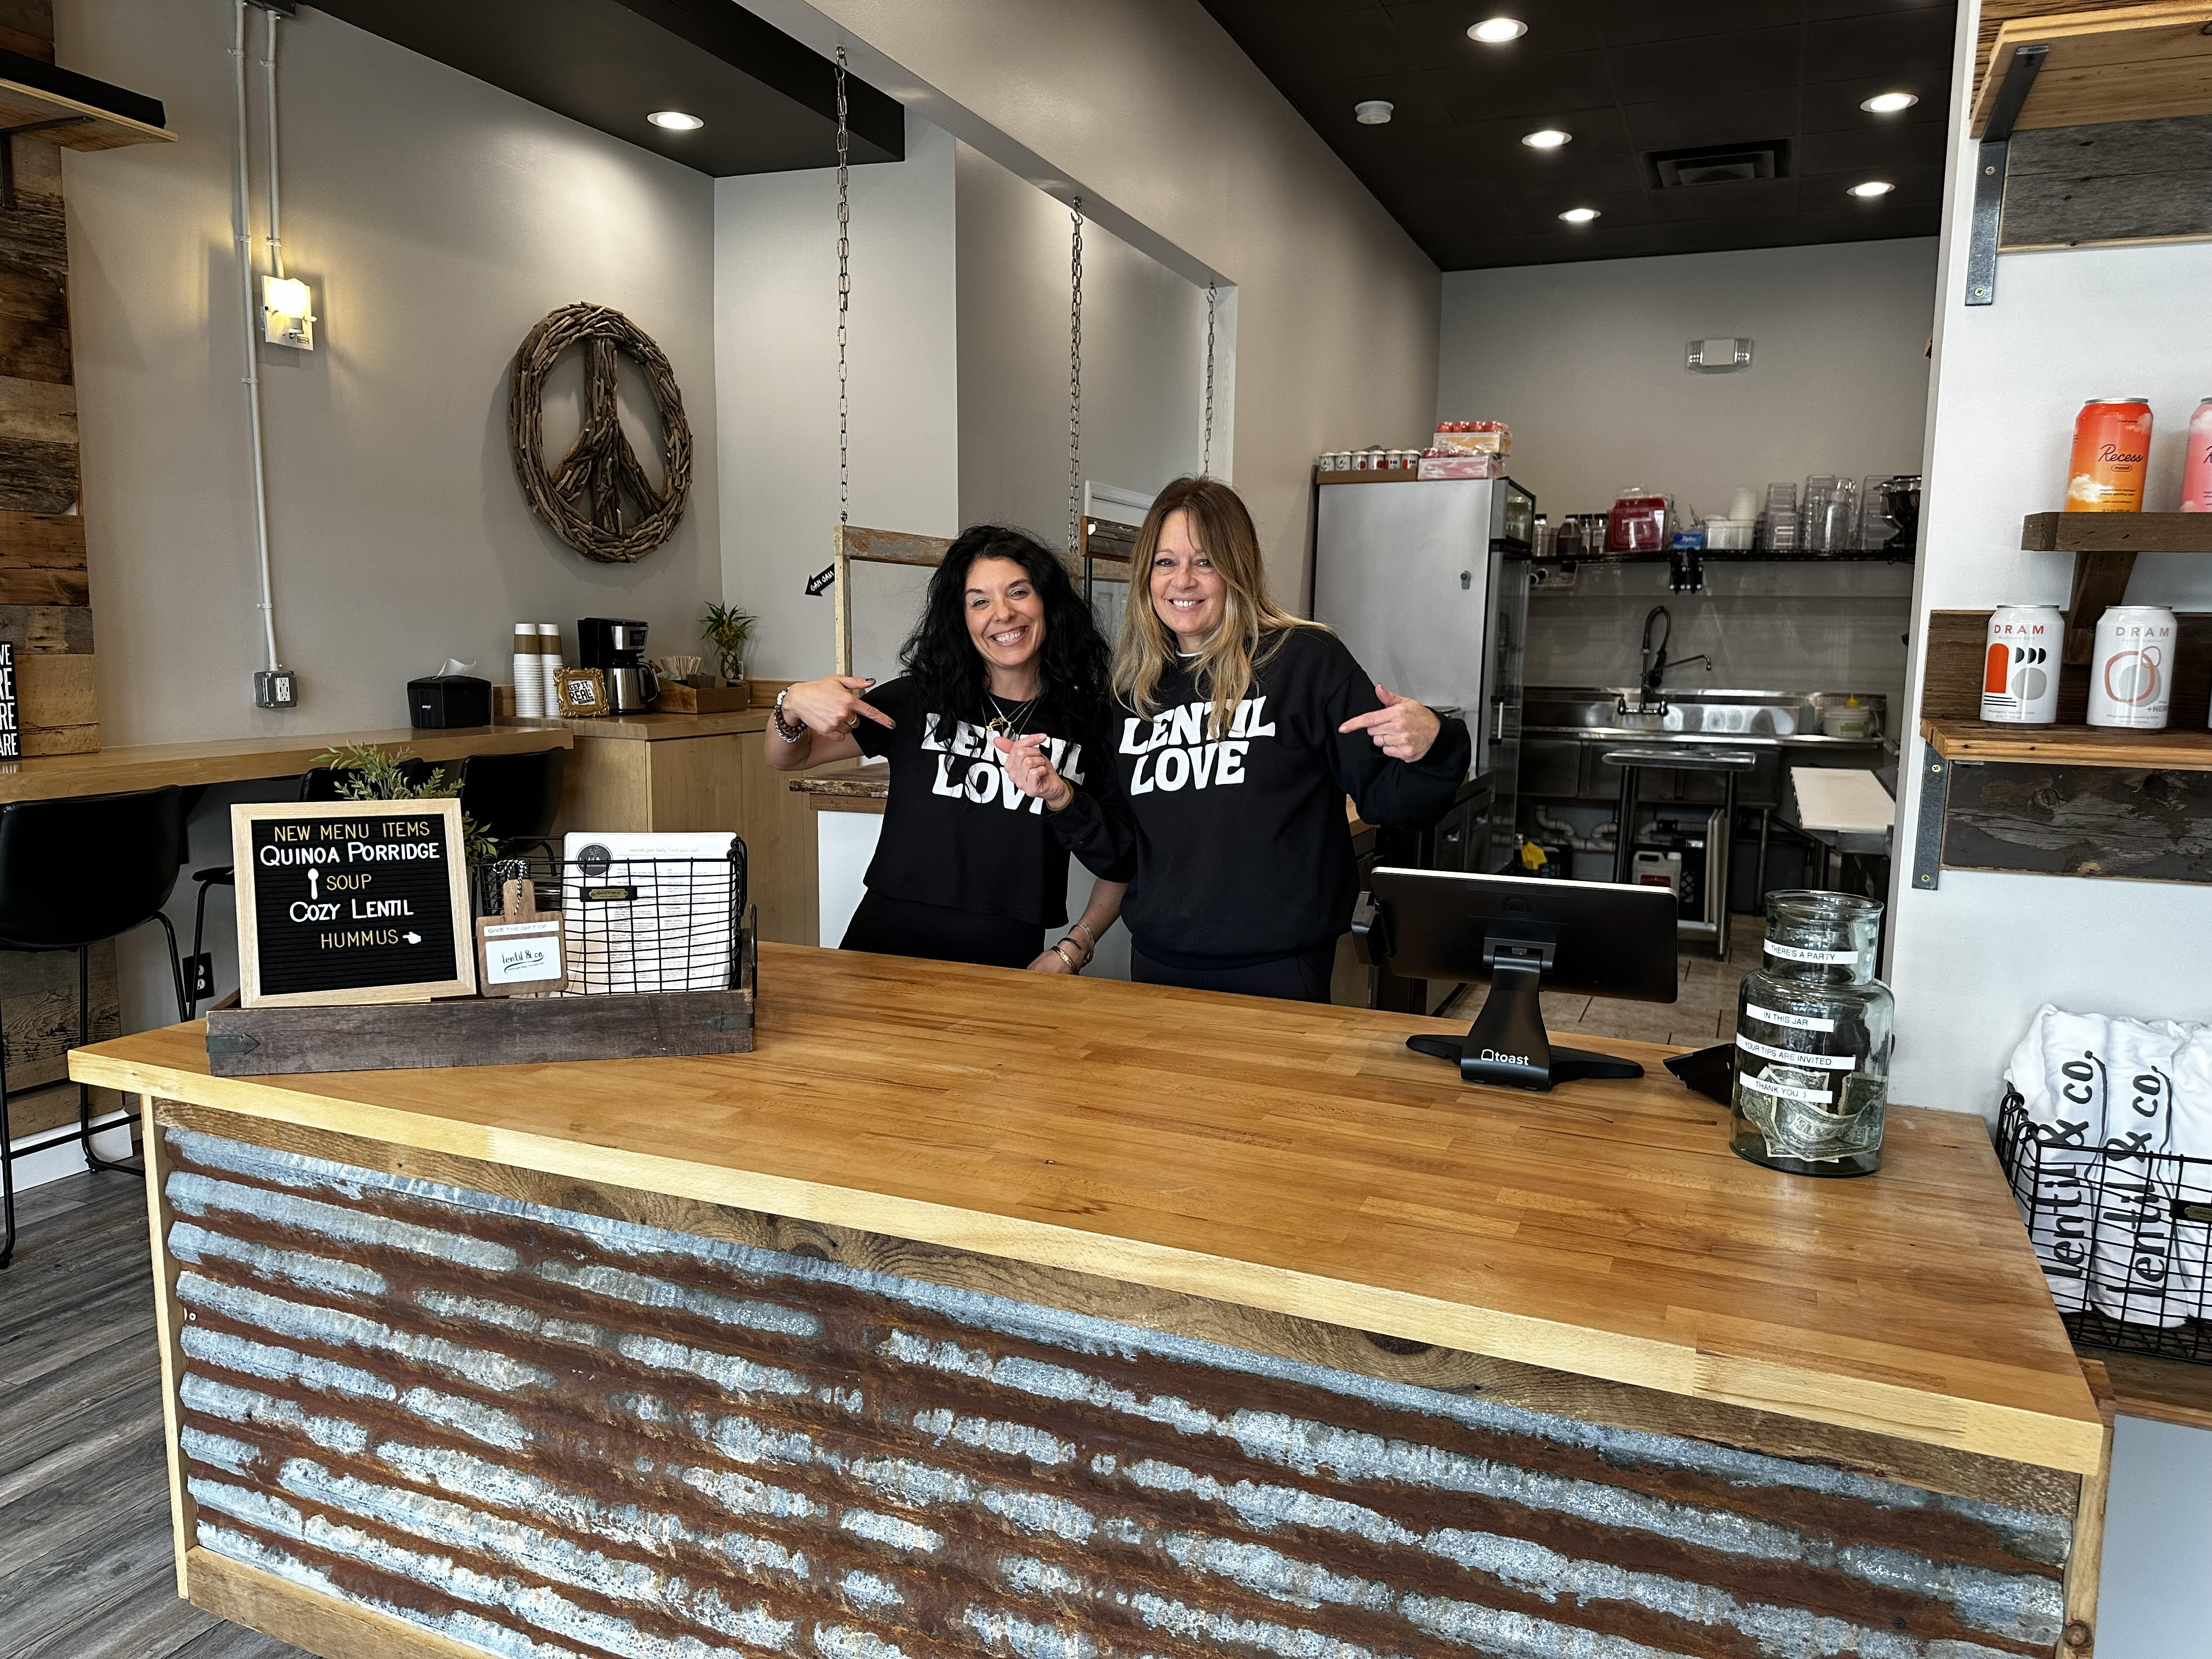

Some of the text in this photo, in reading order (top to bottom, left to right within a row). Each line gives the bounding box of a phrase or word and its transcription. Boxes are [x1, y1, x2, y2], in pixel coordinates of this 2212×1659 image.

[2098, 444, 2143, 462] Recess
[1994, 624, 2044, 634] DRAM
[2115, 627, 2169, 637] DRAM
[1119, 696, 1276, 754] LENTIL
[1131, 741, 1249, 795] LOVE
[932, 754, 1044, 815] LOV
[274, 821, 430, 842] NEW MENU ITEMS
[259, 842, 440, 866] QUINOA PORRIDGE
[326, 873, 372, 891] SOUP
[289, 899, 414, 922] COZY LENTIL
[321, 929, 399, 950] HUMMUS
[501, 951, 523, 964] lentil
[525, 950, 532, 960] &
[1771, 945, 1797, 957] THERE'S
[1807, 952, 1836, 961] PARTY
[1764, 1011, 1771, 1019] IN
[1774, 1014, 1790, 1023] THIS
[1494, 1051, 1529, 1066] toast
[1745, 1041, 1832, 1065] YOUR TIPS ARE INVITED
[1756, 1081, 1779, 1093] THANK
[1781, 1088, 1798, 1097] YOU
[2027, 1050, 2093, 1279] lentil & co.
[2102, 1065, 2165, 1297] lentil & co.
